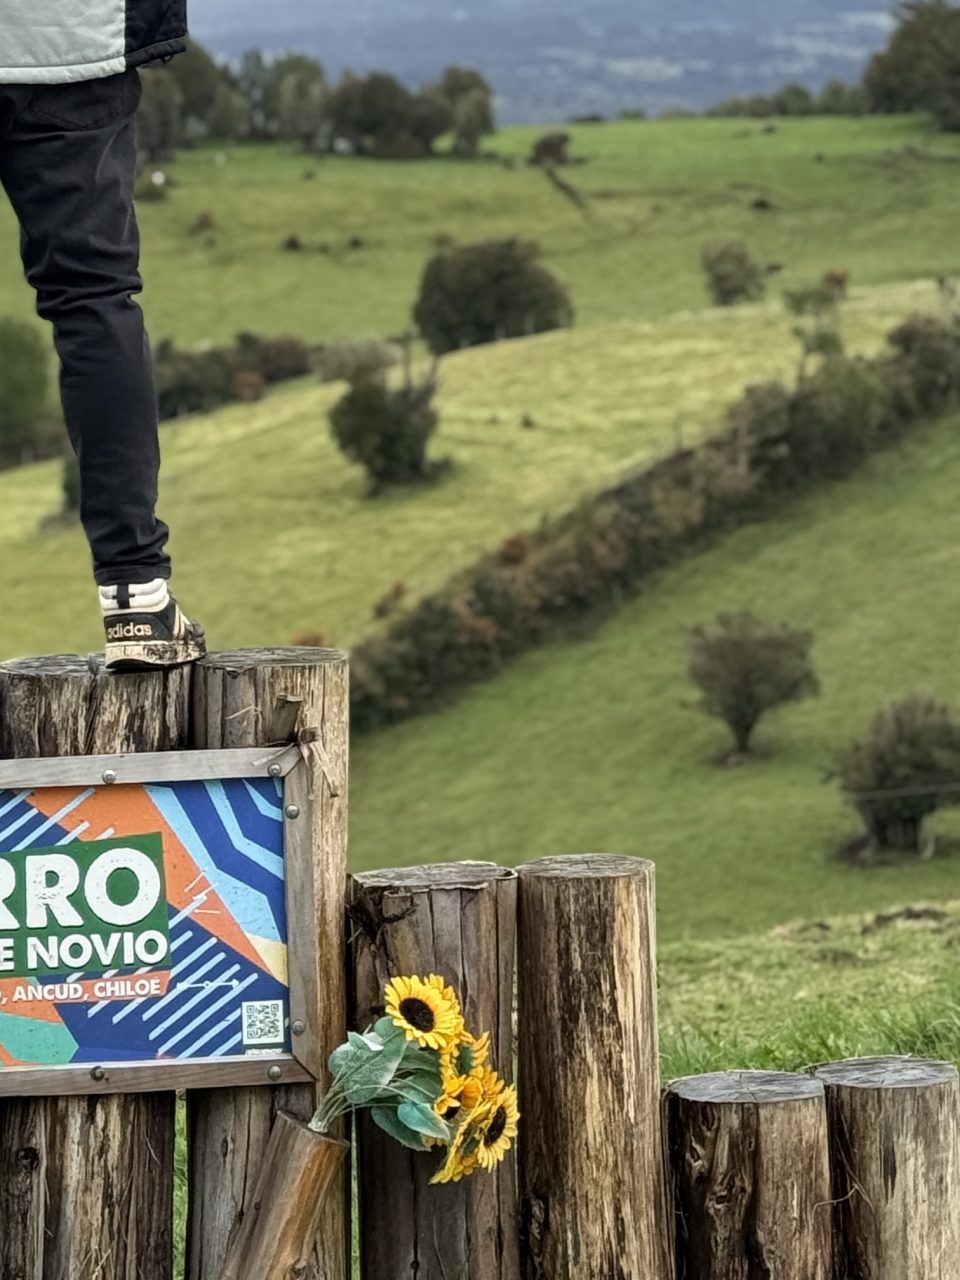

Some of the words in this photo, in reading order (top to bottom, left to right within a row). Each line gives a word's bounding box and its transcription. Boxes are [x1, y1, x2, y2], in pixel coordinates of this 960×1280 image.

[27, 930, 167, 969] NOVIO
[13, 983, 89, 1003] ANCUD,
[93, 976, 161, 998] CHILOÉ
